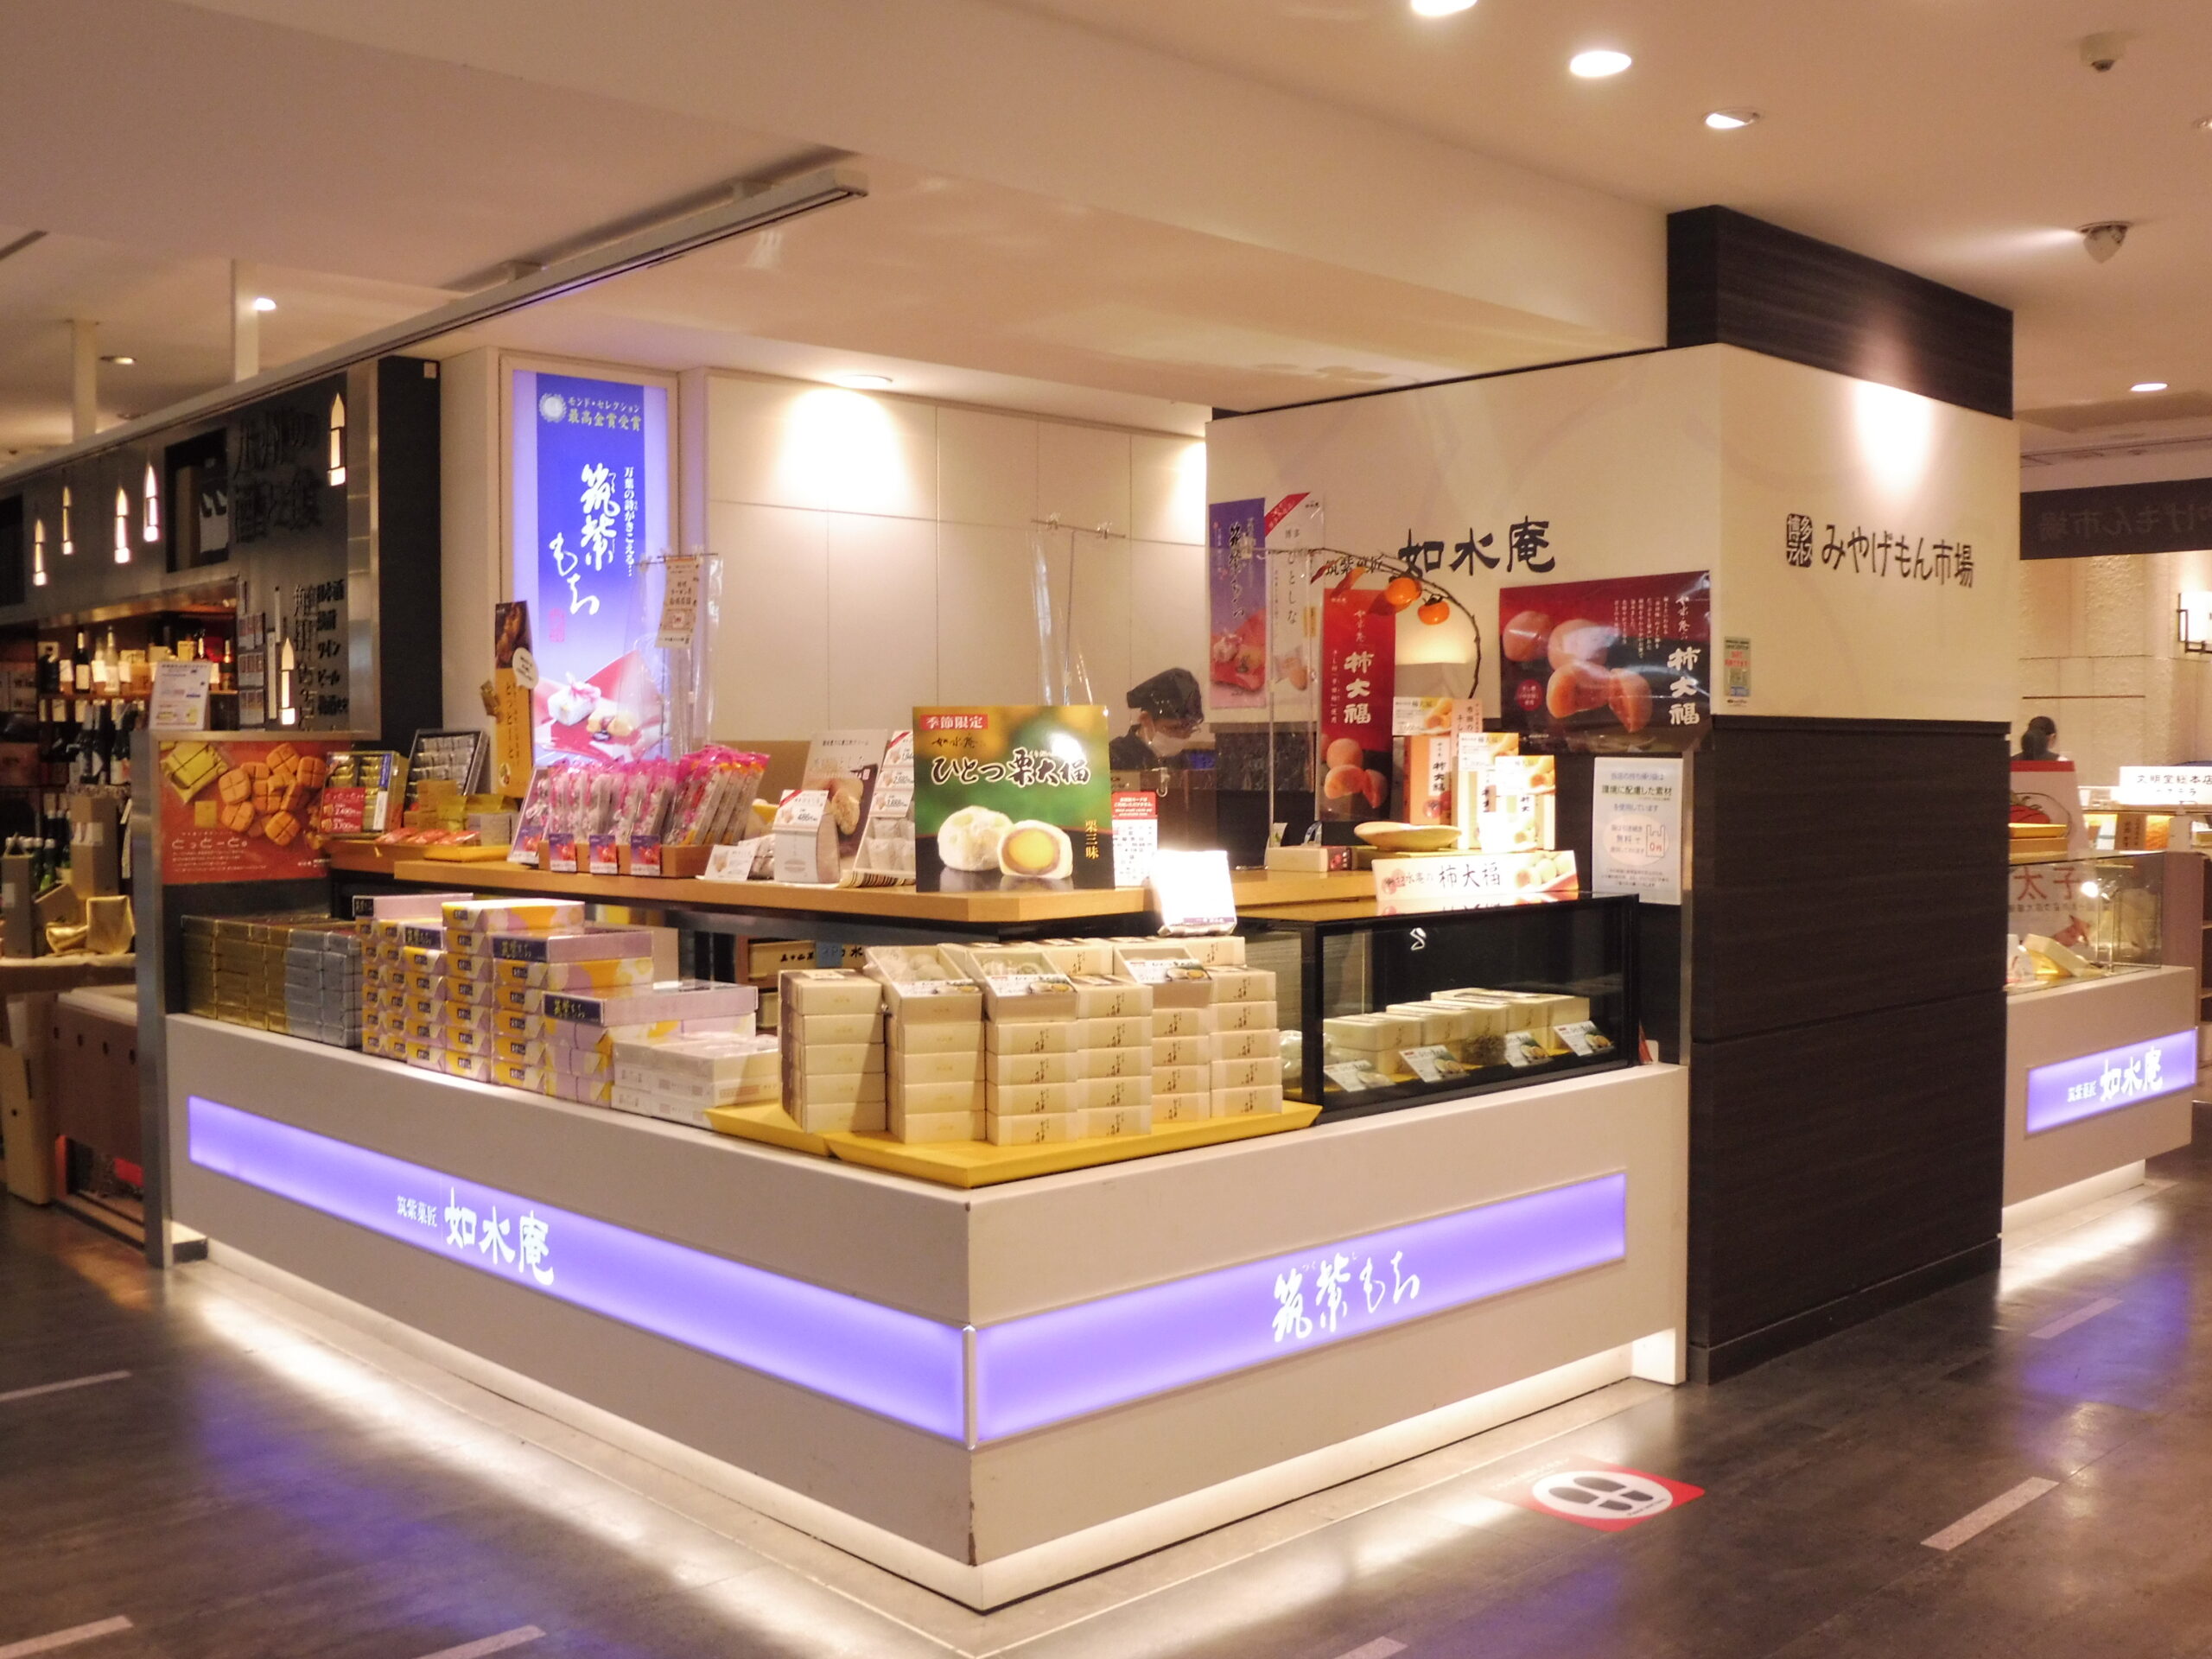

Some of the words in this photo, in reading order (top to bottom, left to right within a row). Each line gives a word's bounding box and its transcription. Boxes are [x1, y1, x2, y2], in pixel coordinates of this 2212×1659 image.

[567, 396, 641, 414] モンド・セレクション
[567, 409, 643, 431] 最高金賞受賞
[1398, 515, 1555, 575] 如水庵
[1821, 524, 1975, 588] みやげもん市場
[1343, 650, 1376, 725] 柿大福
[1666, 645, 1702, 726] 柿大福
[925, 715, 984, 729] 季節限定
[931, 747, 1091, 787] ひとつ栗大福
[1601, 784, 1673, 797] 環境に配慮した素材
[1438, 861, 1502, 889] 柿大福
[2098, 1045, 2164, 1103] 如水庵
[396, 1194, 438, 1228] 筑紫菓匠
[443, 1185, 555, 1287] 如水庵
[1272, 1250, 1420, 1343] 筑紫もち
